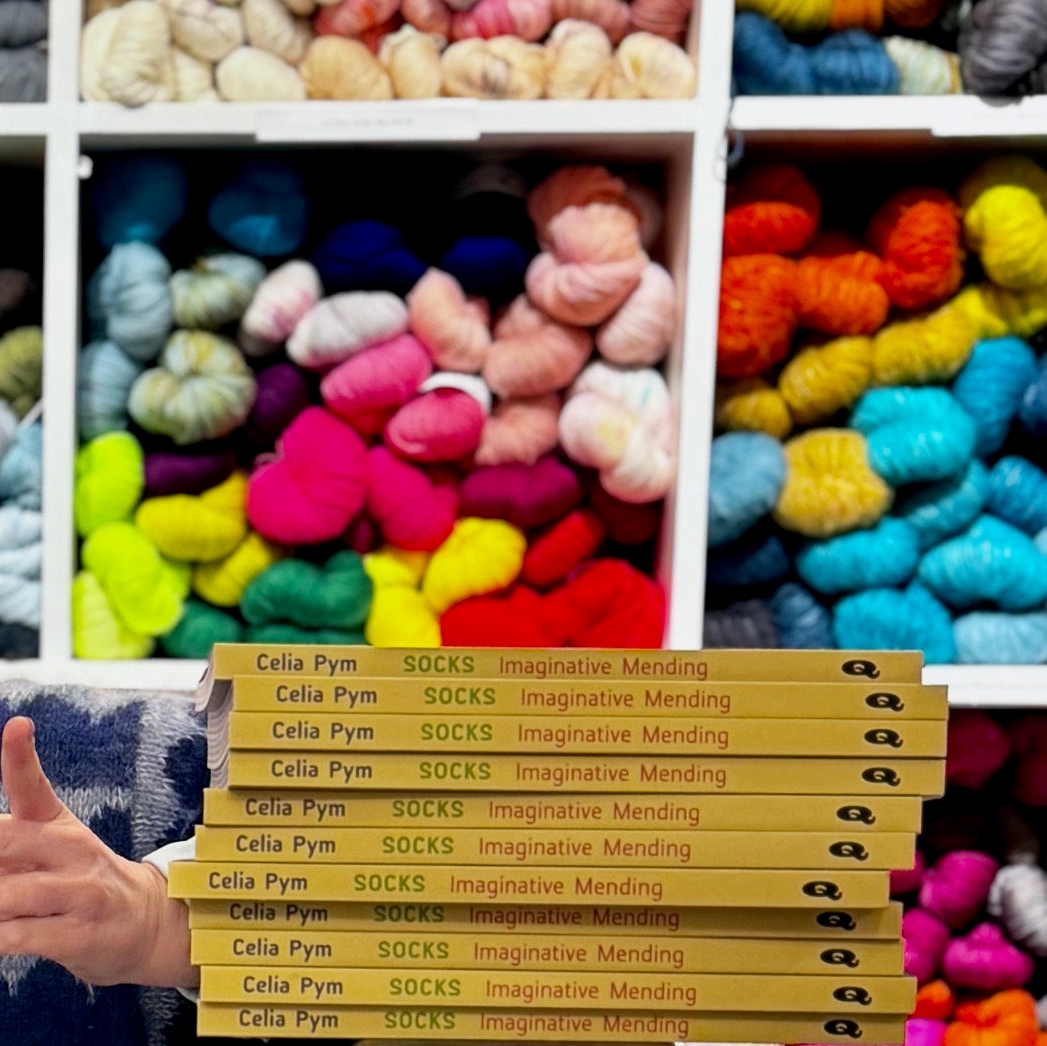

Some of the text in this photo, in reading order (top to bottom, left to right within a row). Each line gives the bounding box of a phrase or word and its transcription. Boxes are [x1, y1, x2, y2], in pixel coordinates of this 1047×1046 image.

[257, 654, 707, 680] Celia Pym SOCKS Imaginative Mending
[276, 685, 730, 713] Celia Pym SOCKS Imaginative Mending
[272, 721, 729, 749] Celia Pym SOCKS Imaginative Mending
[271, 760, 726, 788] Celia Pym SOCKS Imaginative Mending
[245, 798, 700, 826] Celia Pym SOCKS Imaginative Mending
[235, 834, 691, 862] Celia Pym SOCKS Imaginative Mending
[208, 871, 662, 900] Celia Pym SOCKS Imaginative Mending
[230, 903, 679, 932] Celia Pym SOCKS Imaginative Mending
[232, 938, 684, 967] Celia Pym SOCKS Imaginative Mending
[243, 976, 696, 1005] Celia Pym SOCKS Imaginative Mending
[239, 1010, 689, 1038] Celia Pym SOCKS Imaginative Mending
